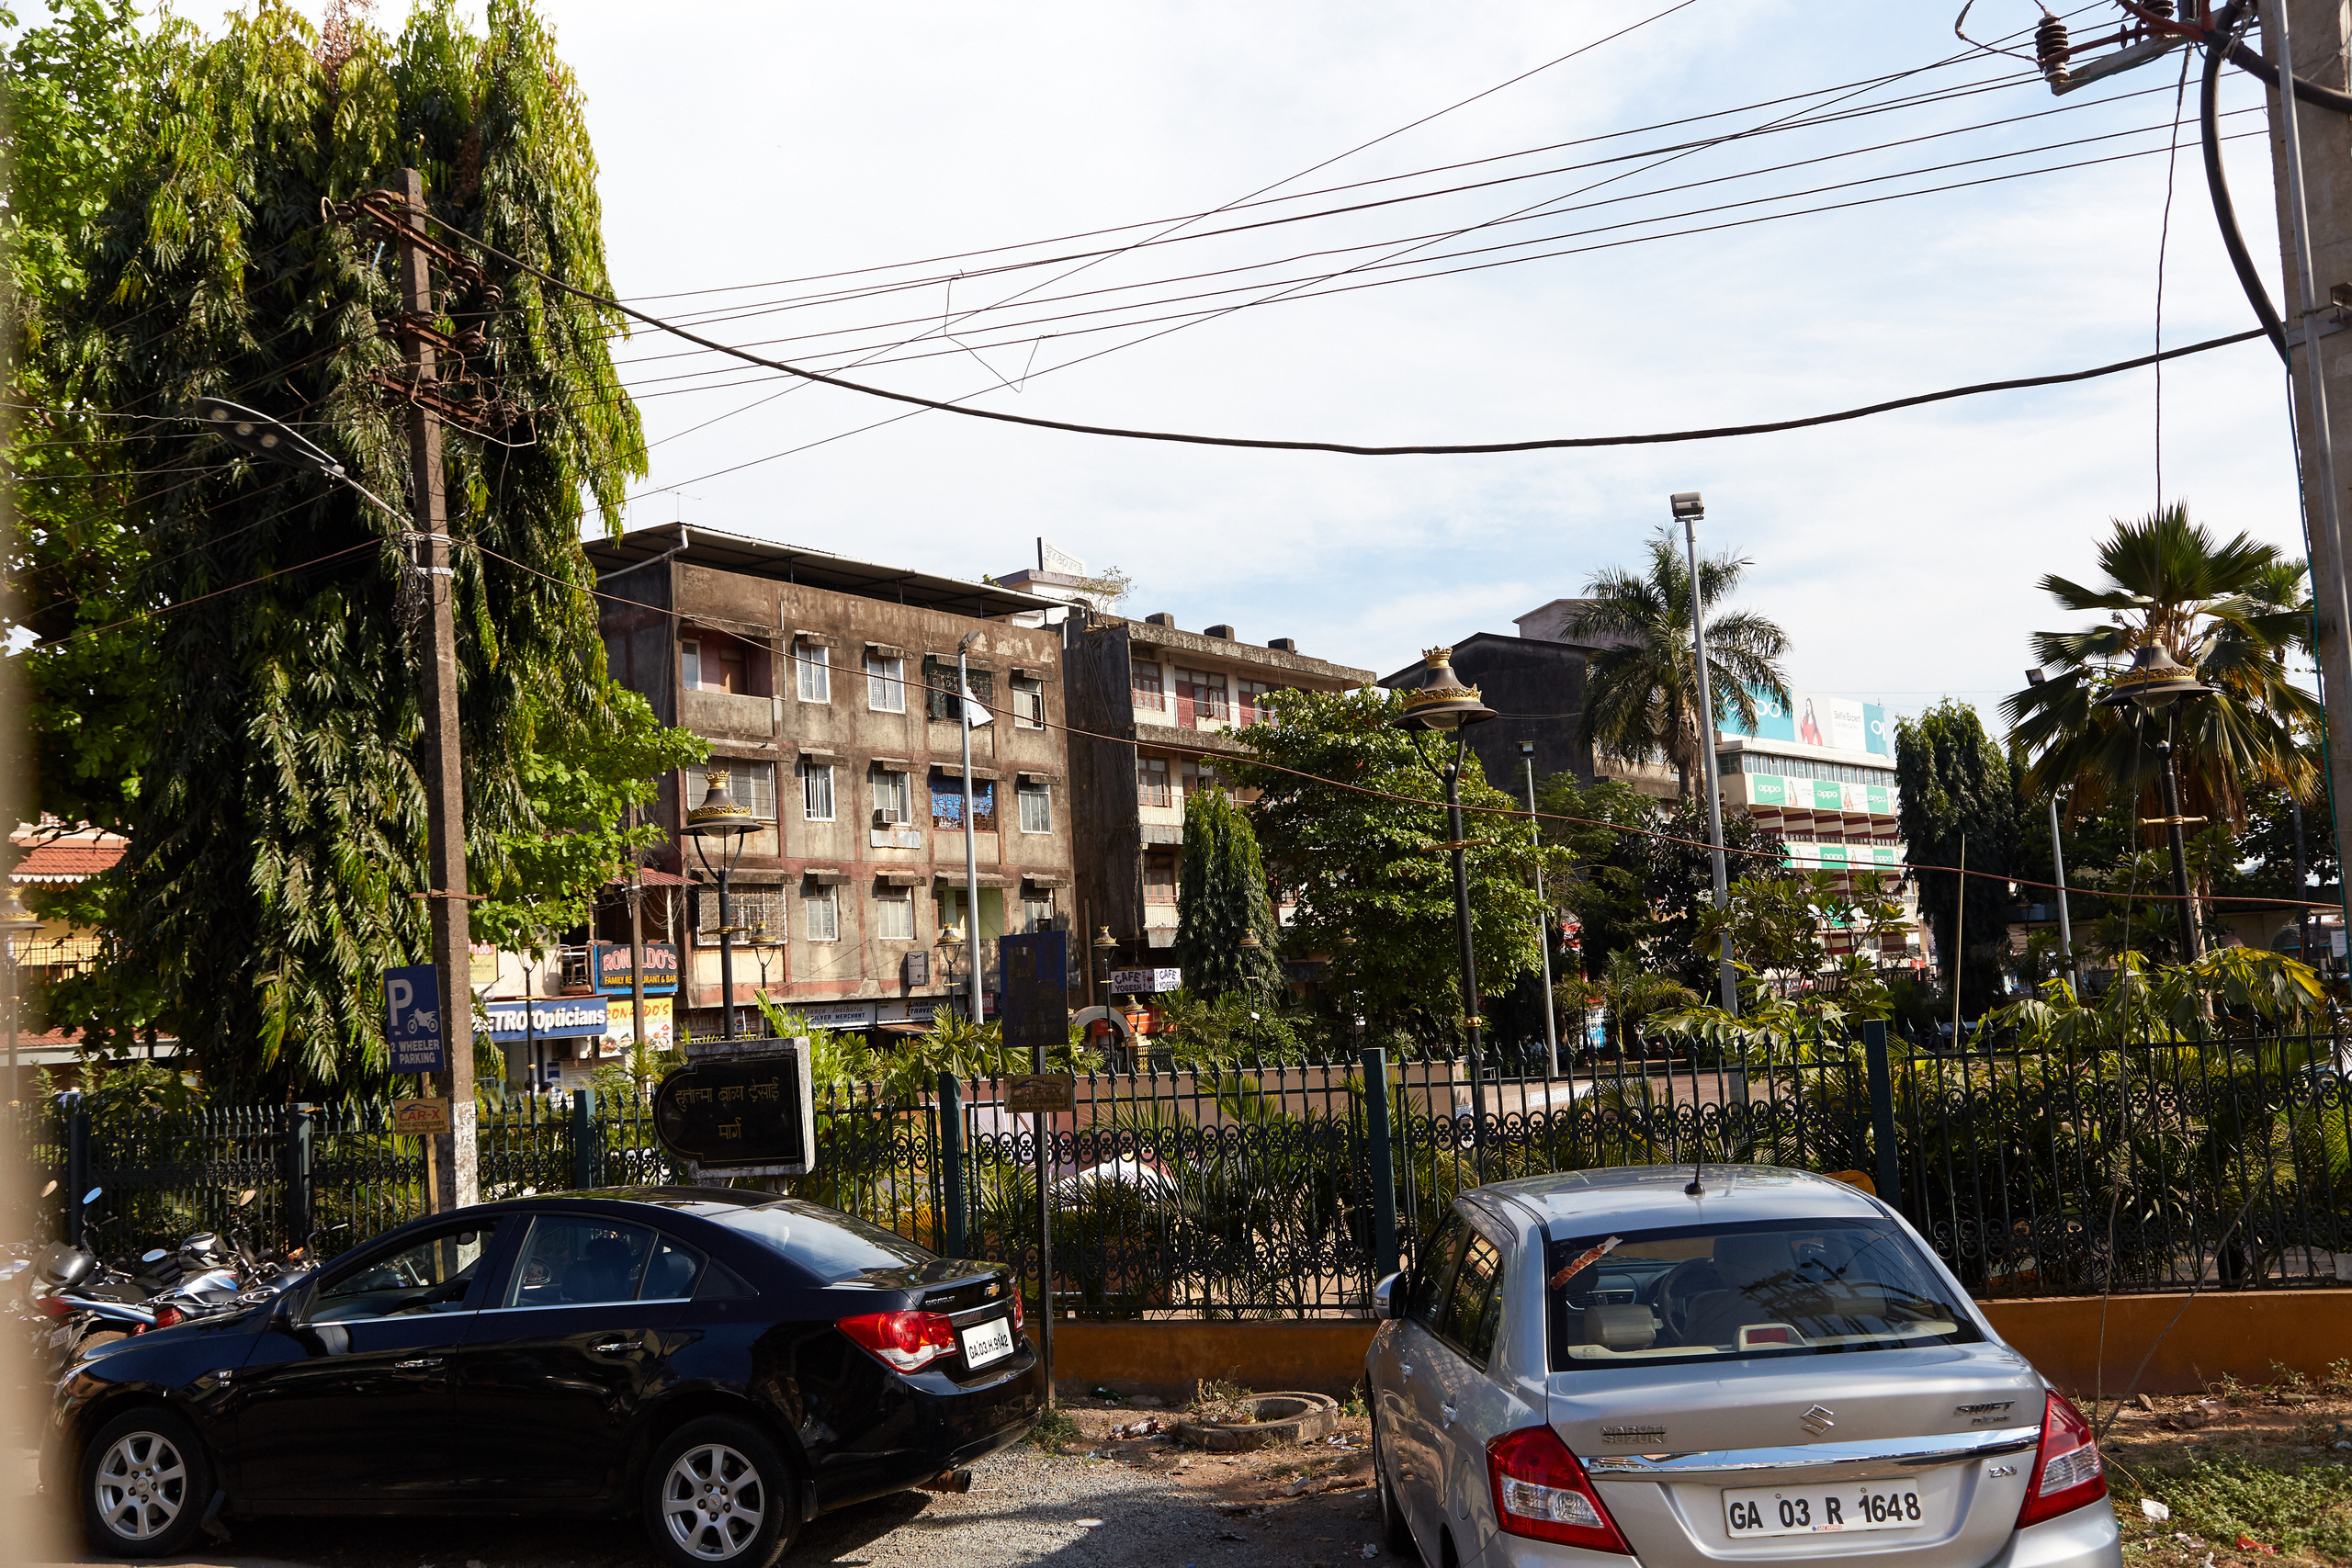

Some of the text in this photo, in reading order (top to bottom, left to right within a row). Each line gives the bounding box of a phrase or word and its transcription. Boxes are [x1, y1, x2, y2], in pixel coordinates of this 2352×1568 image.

[1847, 713, 1861, 724] Expert
[1758, 784, 1781, 794] oppo
[1817, 789, 1838, 798] oppo
[1869, 794, 1886, 803] oppo
[1823, 852, 1844, 862] oppo
[1875, 854, 1893, 863] oppo
[603, 946, 677, 972] RONLDO'S
[605, 976, 624, 985] FAMILY
[625, 975, 660, 984] RERANT
[666, 974, 677, 983] BAR
[1114, 971, 1141, 984] CAFE
[1159, 969, 1177, 980] CAFE
[1114, 984, 1142, 992] YOGESH
[387, 978, 413, 1027] P
[533, 1006, 605, 1032] Opticians
[390, 1039, 440, 1053] 2 WHEELER
[399, 1052, 436, 1065] PARKING
[400, 1109, 441, 1122] CAR-X
[718, 1117, 742, 1140] मार्ग
[1953, 1400, 2016, 1416] SWIFT
[1600, 1425, 1667, 1435] MARUTI
[1602, 1434, 1667, 1445] SUZUKI
[1730, 1492, 1921, 1530] GA 03 R 1648
